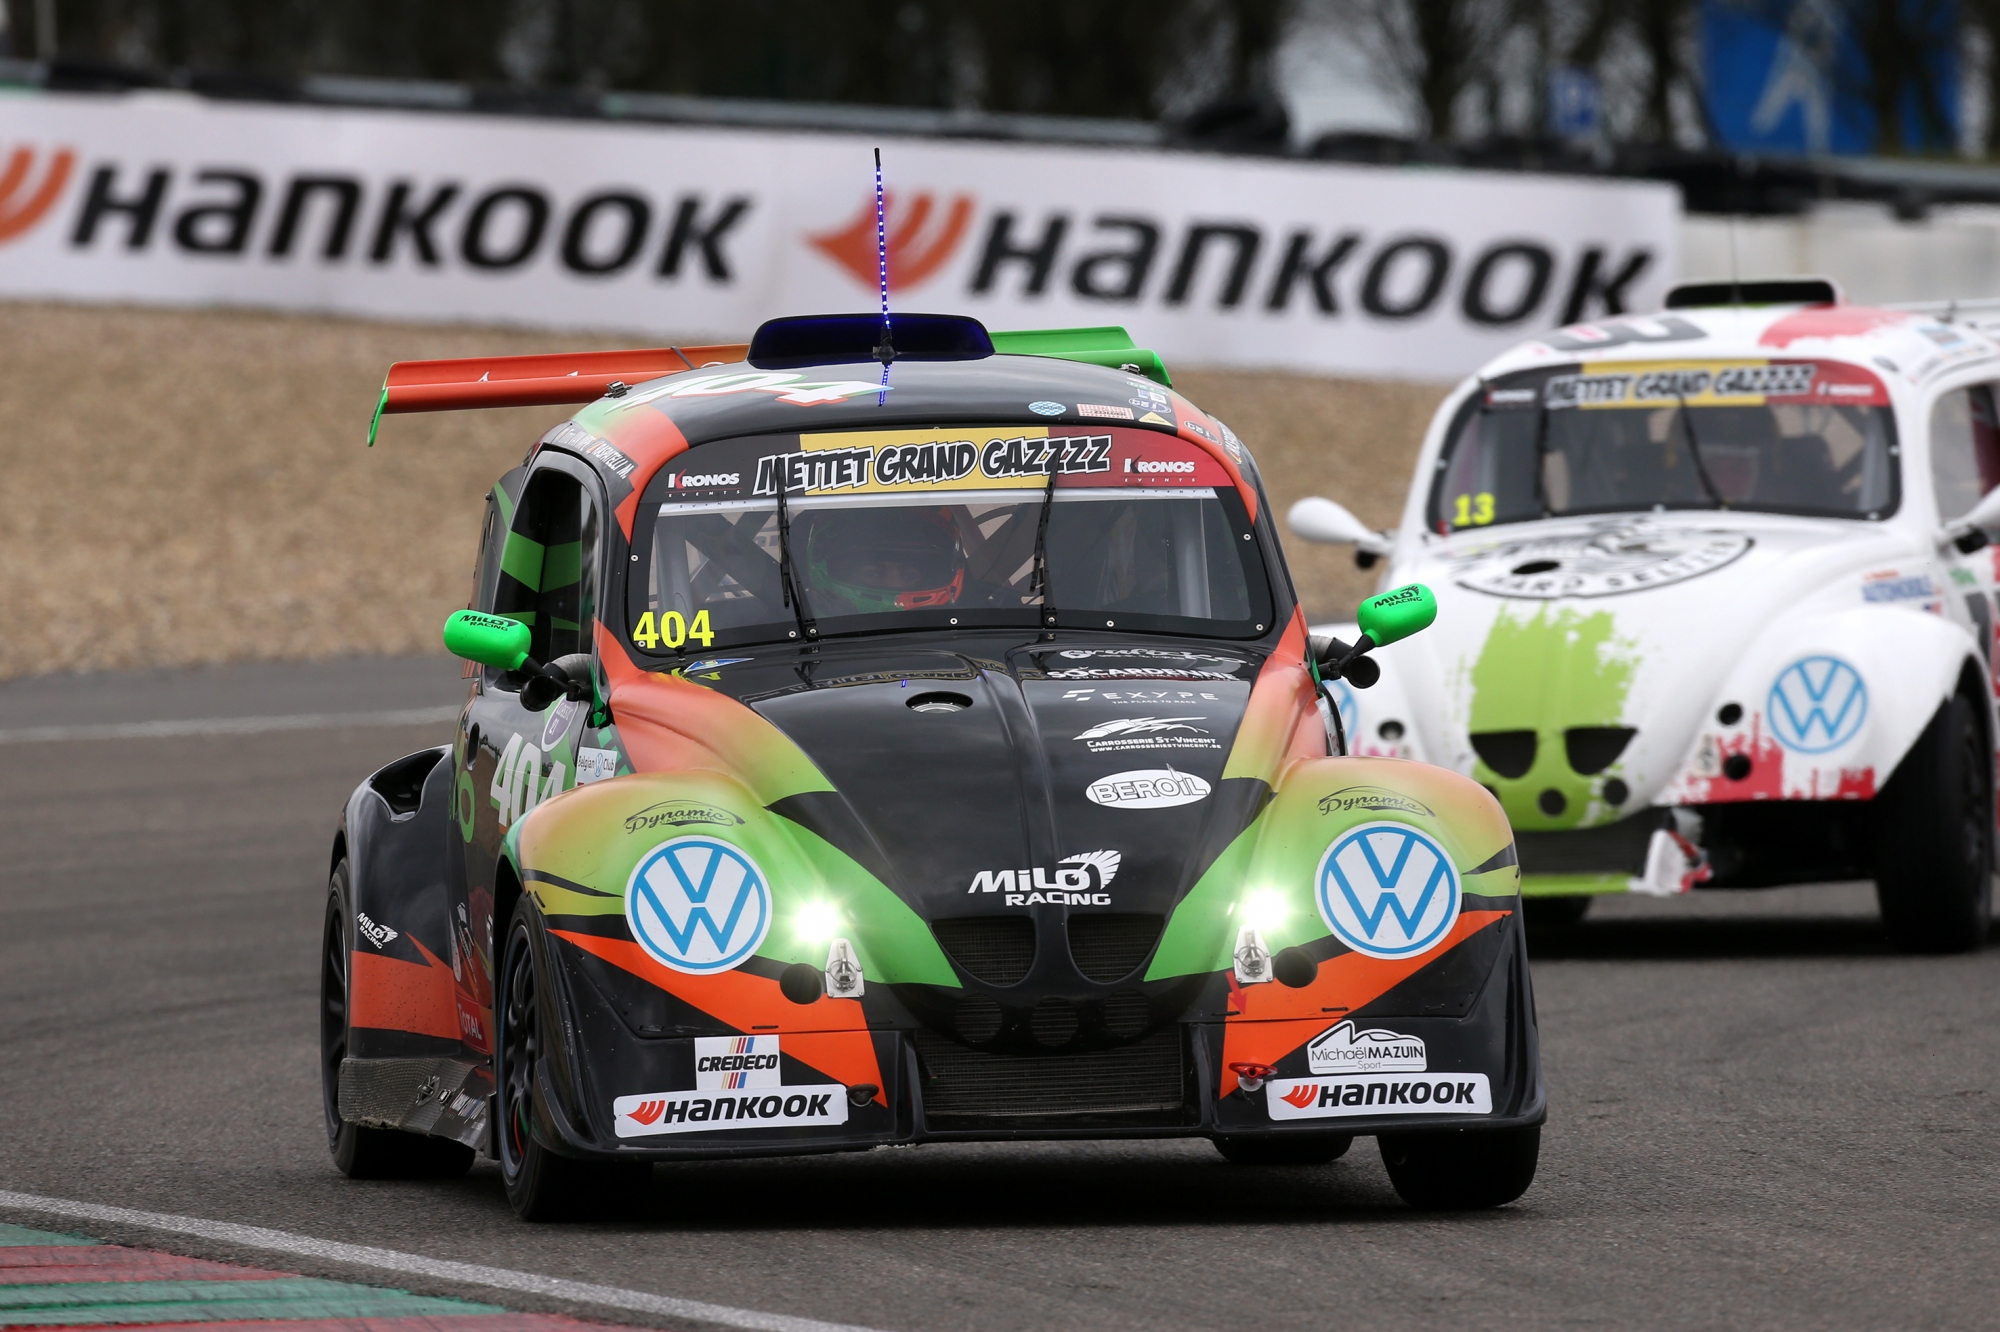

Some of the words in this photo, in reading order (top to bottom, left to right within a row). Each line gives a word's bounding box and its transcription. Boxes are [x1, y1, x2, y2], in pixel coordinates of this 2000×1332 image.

[752, 446, 876, 496] METTET
[874, 440, 979, 486] GRAND
[980, 434, 1112, 480] GAZZZZ
[668, 489, 741, 498] EVENTS
[1453, 493, 1495, 526] 13
[1388, 597, 1422, 607] RACING
[469, 621, 509, 631] RACING
[633, 610, 714, 649] 404
[1103, 692, 1219, 700] EXYPE
[578, 755, 594, 772] Belgian
[603, 758, 615, 772] Club
[1319, 795, 1426, 816] Dynamic
[626, 808, 734, 835] Dynamic
[1005, 891, 1112, 906] RACING
[359, 925, 383, 949] RACING
[457, 1003, 482, 1041] TOTAL
[698, 1054, 778, 1073] CREDECO
[1357, 1060, 1381, 1071] Sport
